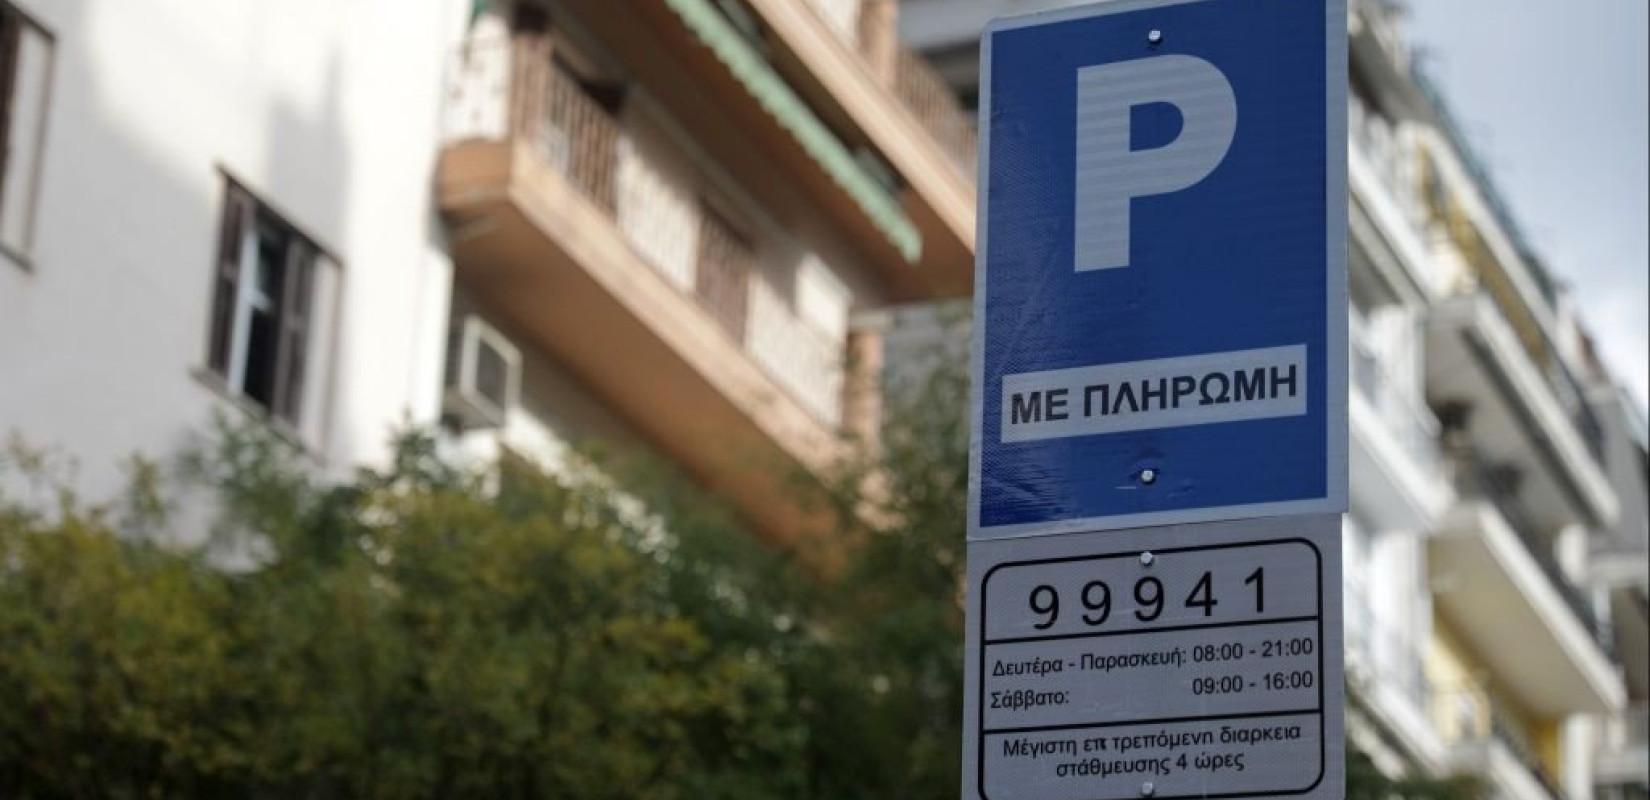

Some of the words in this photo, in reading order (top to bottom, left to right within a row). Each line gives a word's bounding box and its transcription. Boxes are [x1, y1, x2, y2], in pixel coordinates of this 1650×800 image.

[1074, 54, 1237, 271] P
[1011, 388, 1069, 425] ΜΕ
[1083, 364, 1298, 417] ΠΛΗΡΩΜΗ
[1028, 566, 1265, 630] 99941
[992, 659, 1063, 677] Δευτέρα
[1081, 648, 1187, 672] Παρασκευή:
[1192, 645, 1244, 663] 08:00
[1262, 638, 1313, 657] 21:00
[990, 690, 1070, 711] Σάββατο:
[1192, 677, 1244, 695] 09:00
[1264, 671, 1313, 690] 16:00
[1003, 736, 1078, 759] Μέγιστη
[1220, 724, 1301, 746] διαρκεια
[1056, 754, 1171, 778] στάθμευσης
[1175, 753, 1188, 770] 4
[1194, 752, 1245, 774] ώρες
